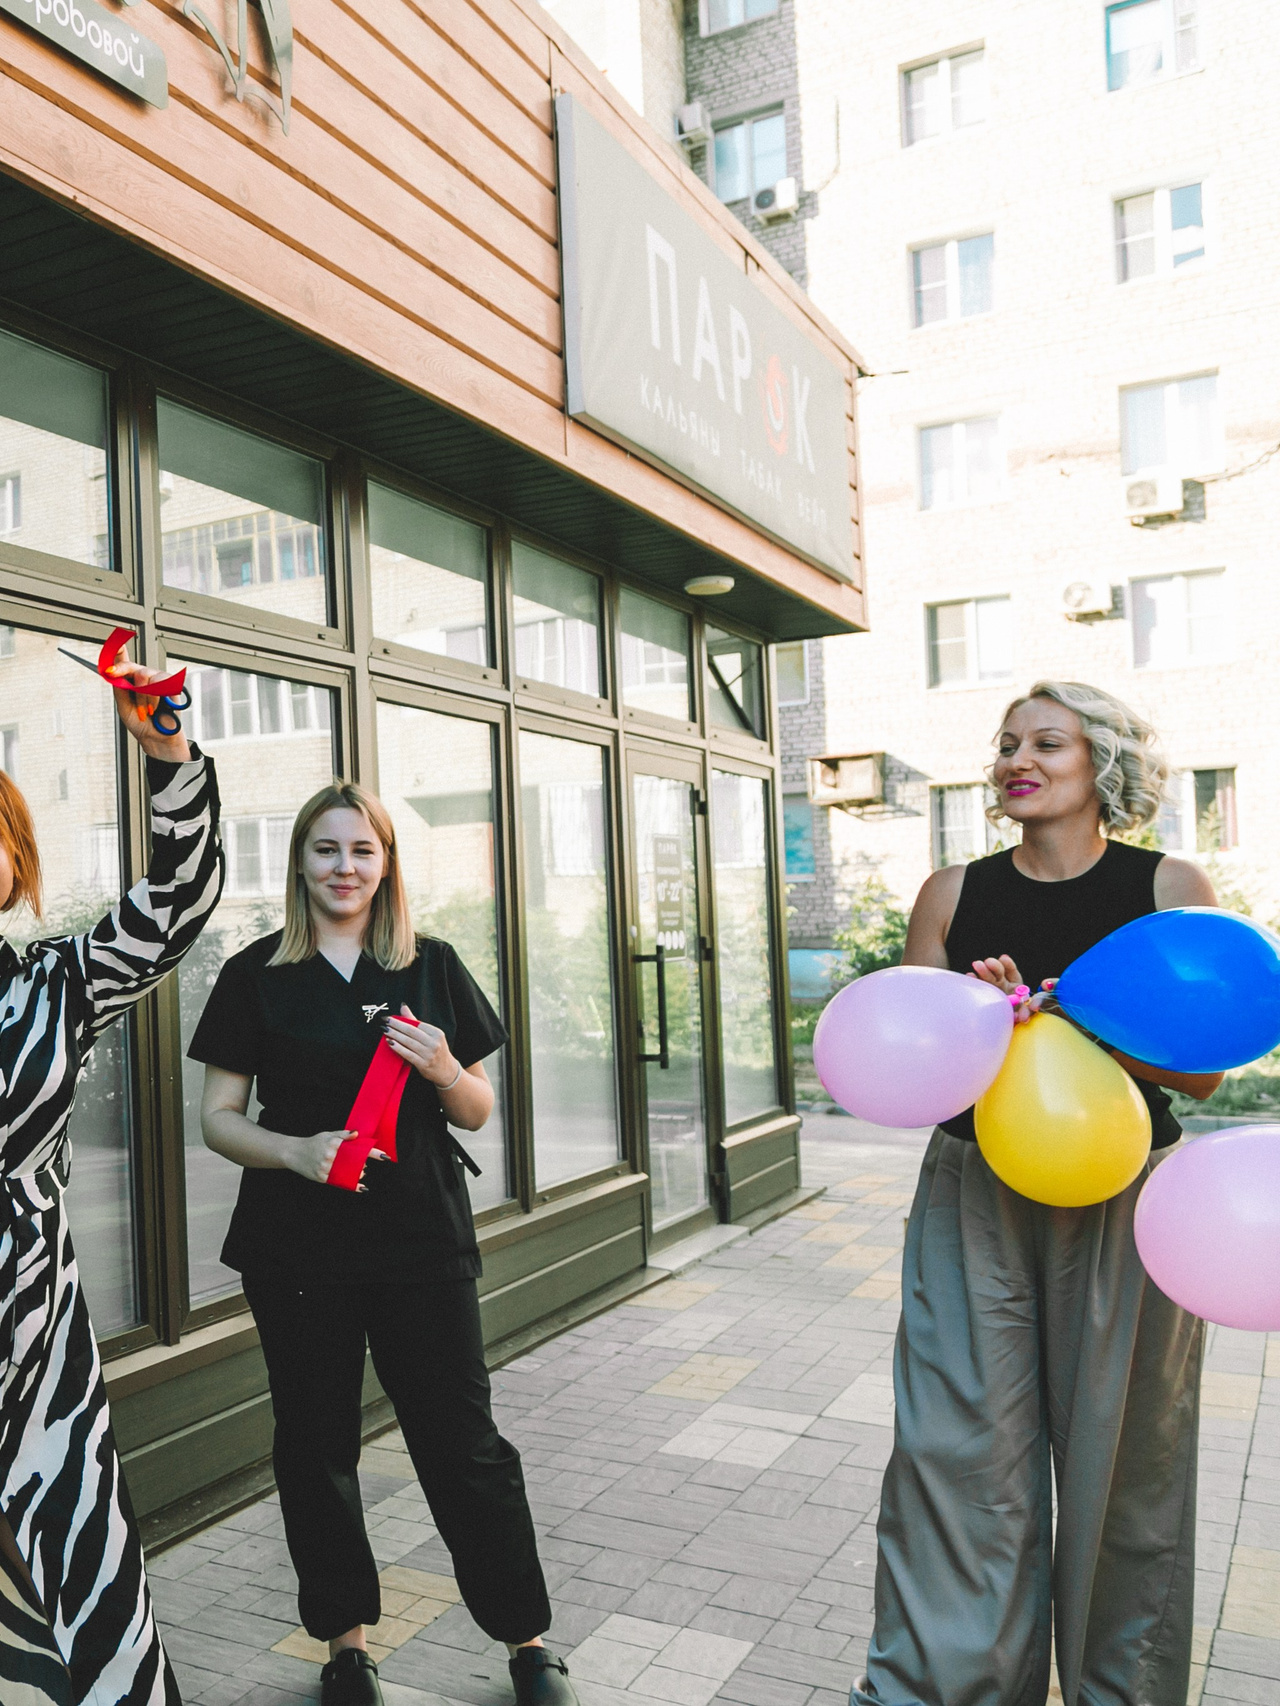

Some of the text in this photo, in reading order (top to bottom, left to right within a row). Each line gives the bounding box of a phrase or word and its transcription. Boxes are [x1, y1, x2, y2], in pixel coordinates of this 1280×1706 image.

[23, 0, 145, 78] робовой
[639, 373, 720, 457] КАЛЬЯНЫ
[740, 448, 782, 503] ТАБАК
